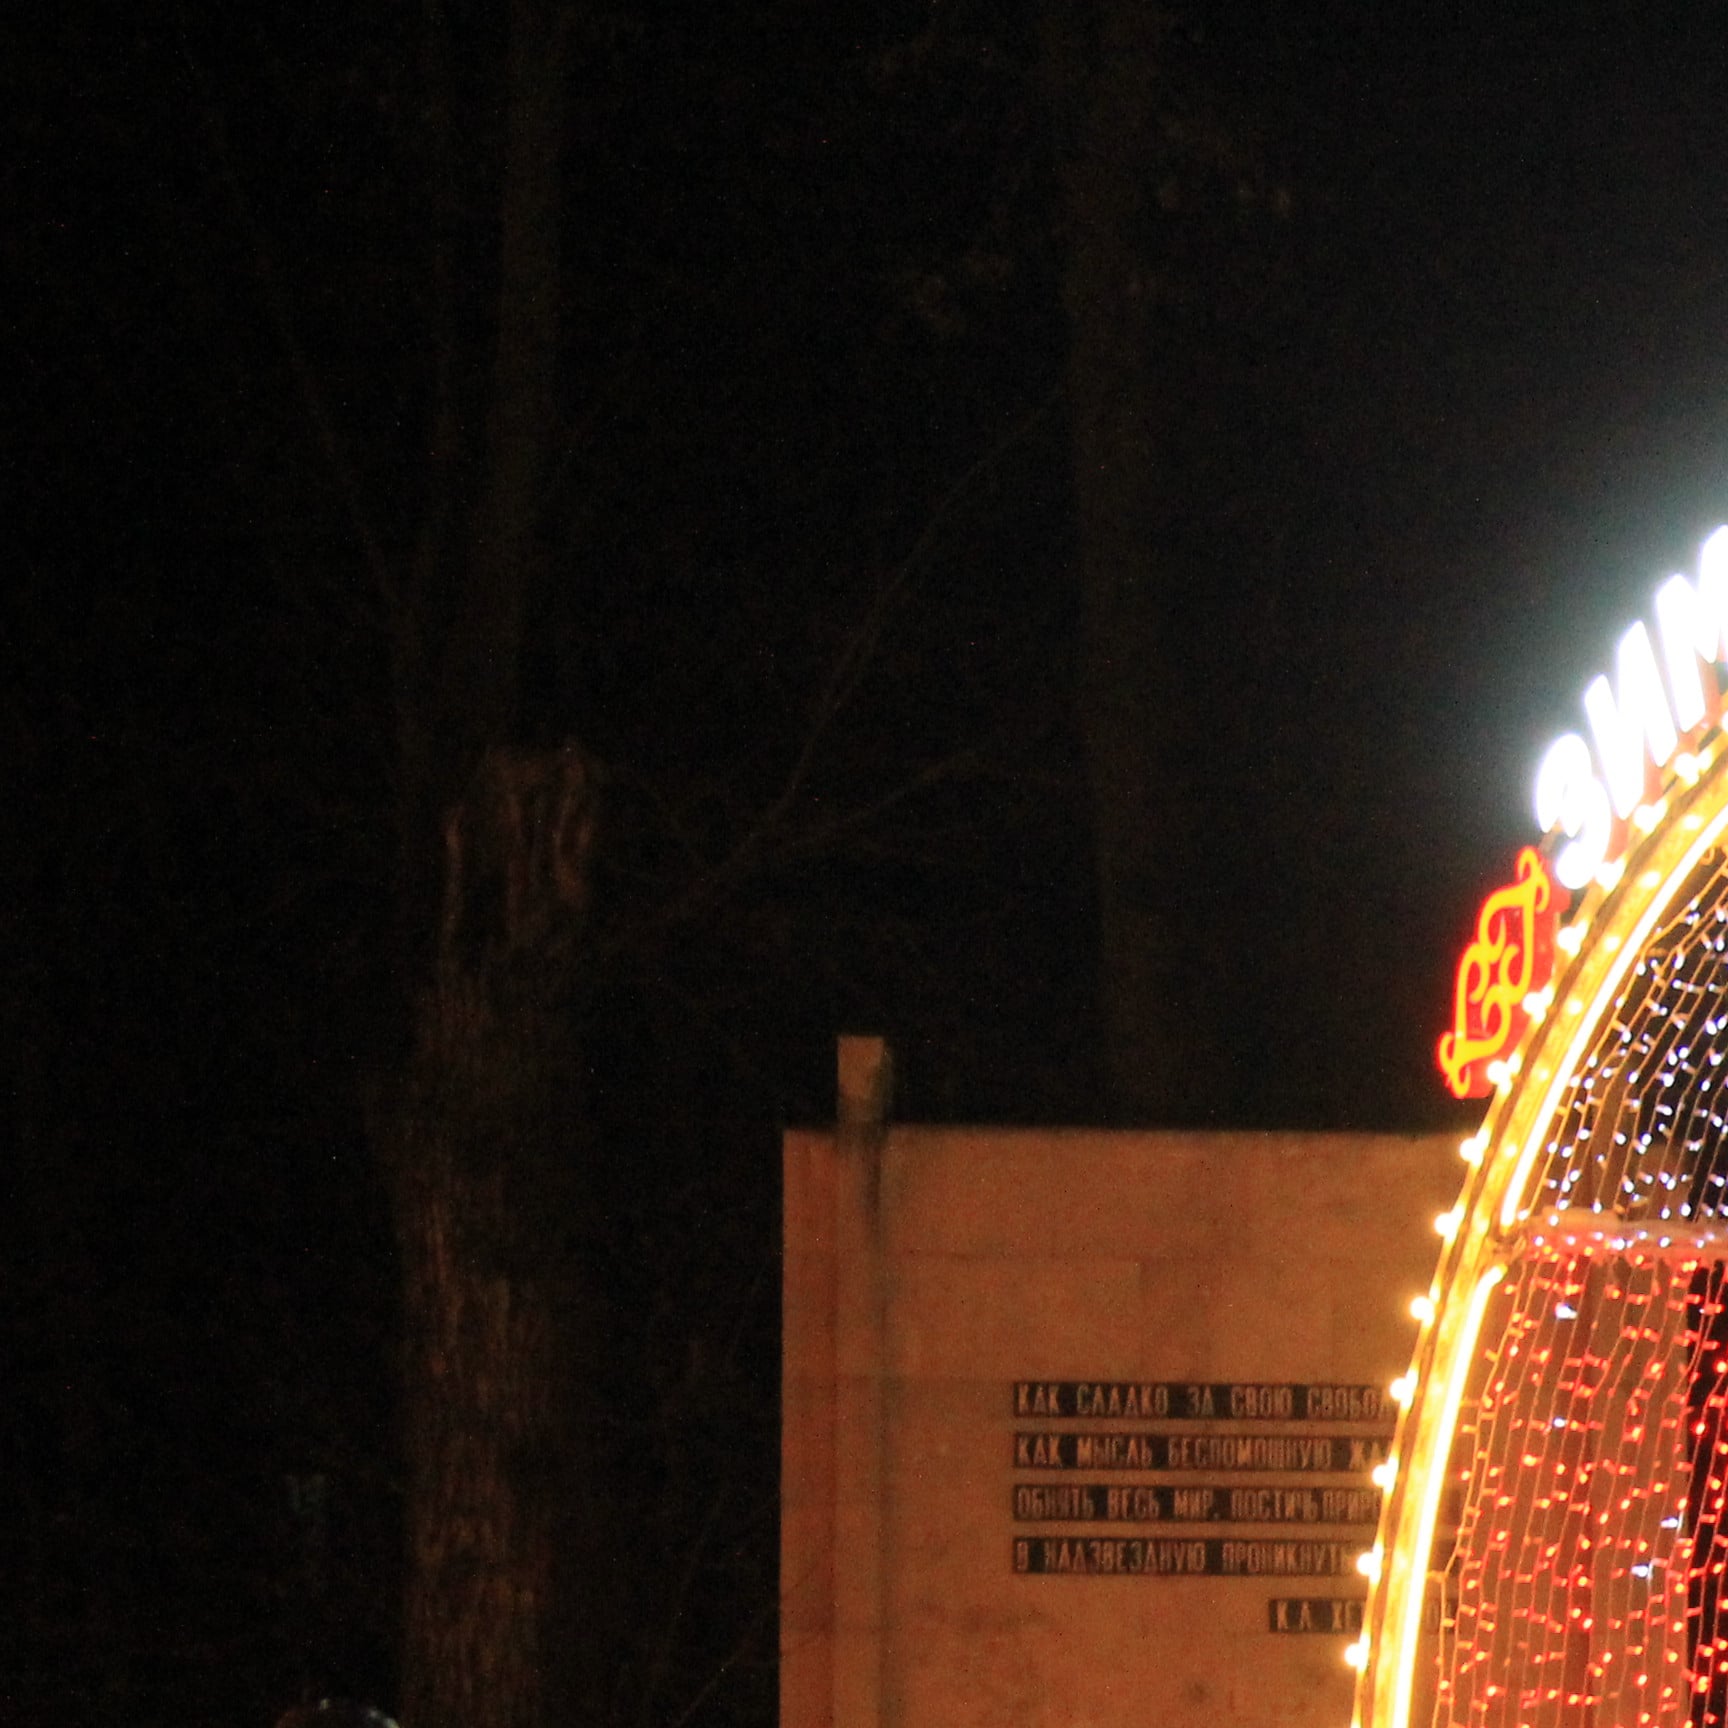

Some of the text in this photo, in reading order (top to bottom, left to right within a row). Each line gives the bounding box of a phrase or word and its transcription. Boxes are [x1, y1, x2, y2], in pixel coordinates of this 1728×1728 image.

[1018, 1383, 1060, 1414] КАК
[1077, 1384, 1169, 1416] СЛАДКО
[1186, 1385, 1214, 1417] ЗА
[1231, 1385, 1293, 1418] СВОЮ
[1018, 1435, 1063, 1466] КАК
[1076, 1436, 1153, 1468] МЫСЛЬ
[1107, 1487, 1160, 1519] ВЕСЬ
